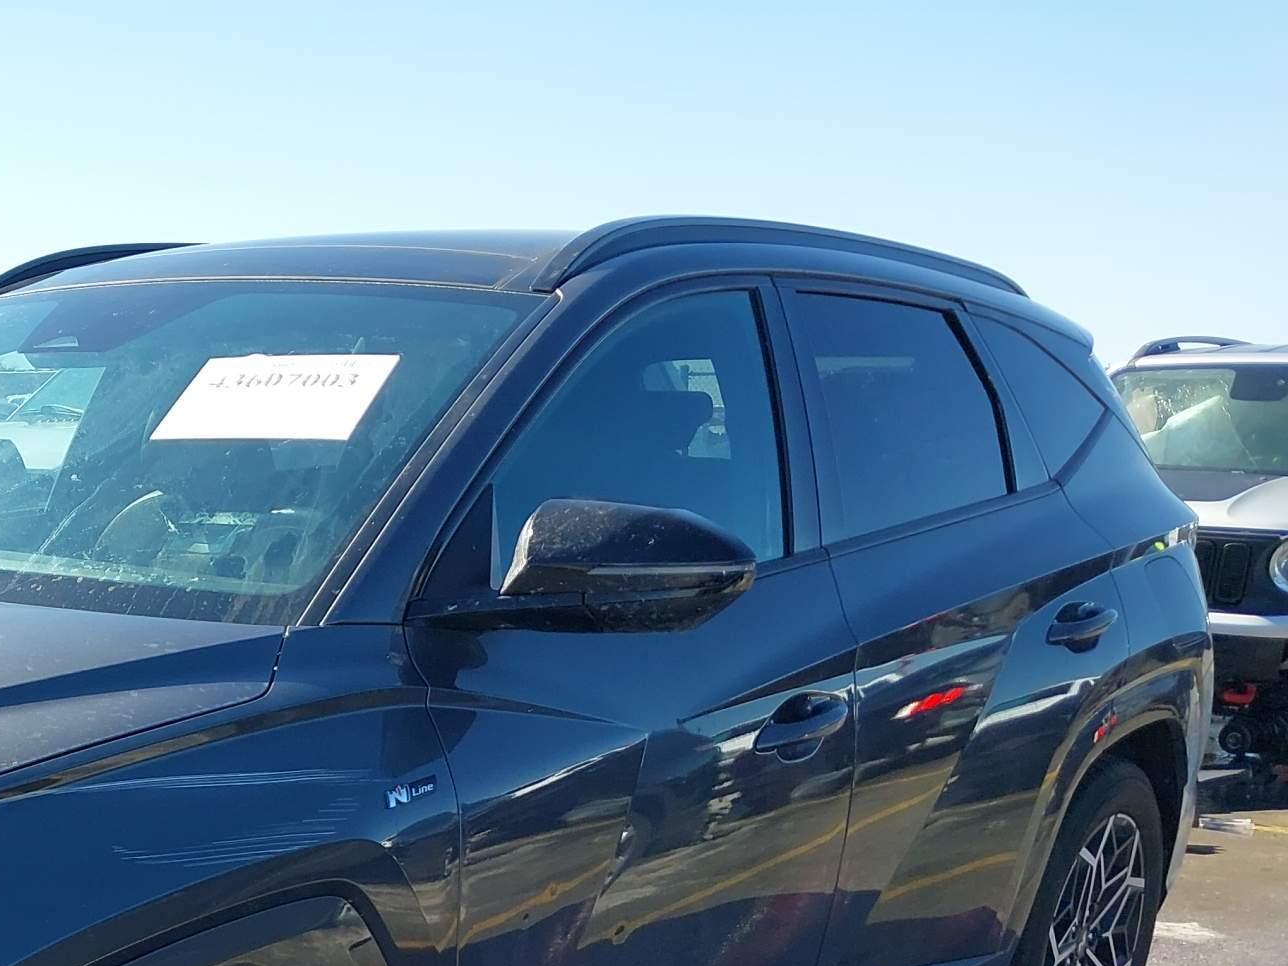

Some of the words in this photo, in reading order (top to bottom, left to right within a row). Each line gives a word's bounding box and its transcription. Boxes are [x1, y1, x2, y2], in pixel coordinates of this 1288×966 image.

[208, 372, 360, 389] 43607003
[387, 784, 411, 808] N
[411, 783, 434, 797] Line
